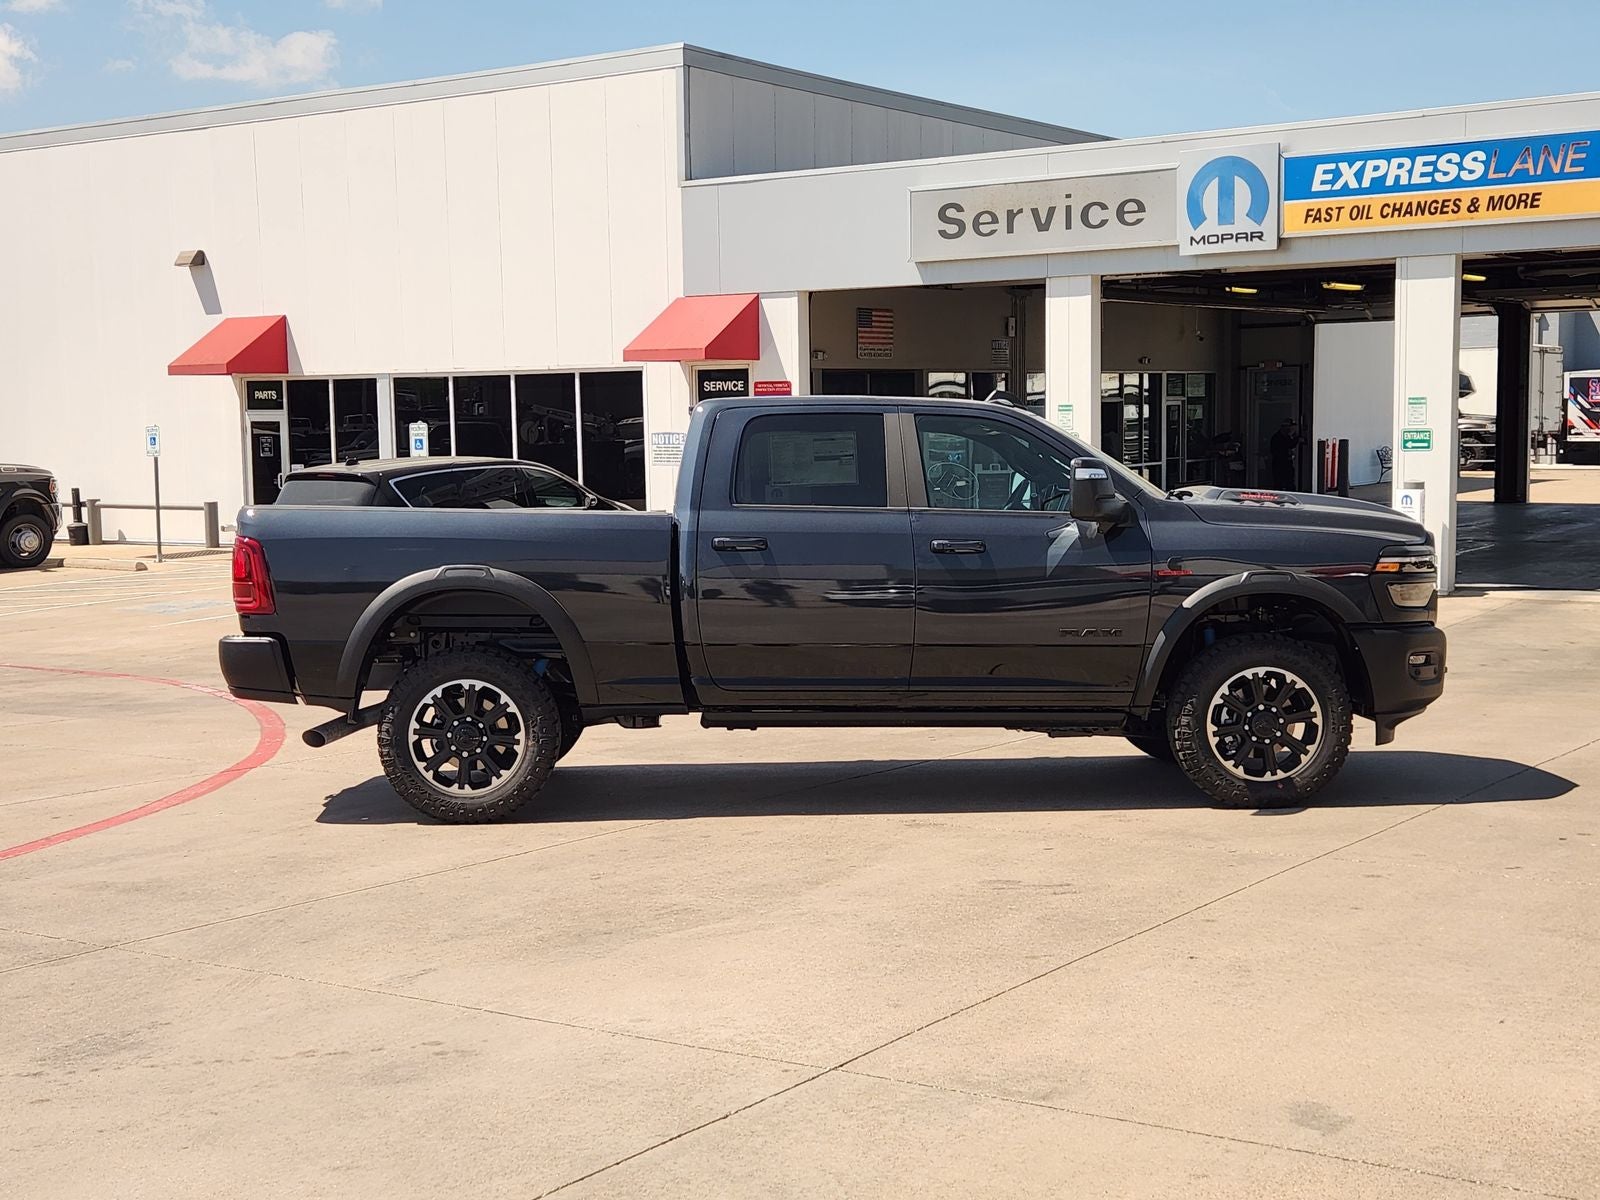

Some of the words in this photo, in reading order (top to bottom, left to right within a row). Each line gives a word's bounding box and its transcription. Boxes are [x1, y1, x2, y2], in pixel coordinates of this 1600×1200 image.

[1304, 205, 1345, 224] FAST
[1349, 203, 1374, 222] OIL
[1380, 197, 1462, 219] CHANGES
[1466, 197, 1481, 214] &
[1486, 192, 1543, 212] MORE
[937, 193, 1147, 240] Service
[1190, 230, 1266, 246] MOPAR
[703, 381, 745, 391] SERVICE
[254, 390, 277, 400] PARTS
[652, 433, 685, 445] NOTICE
[1404, 432, 1431, 440] ENTRANCE
